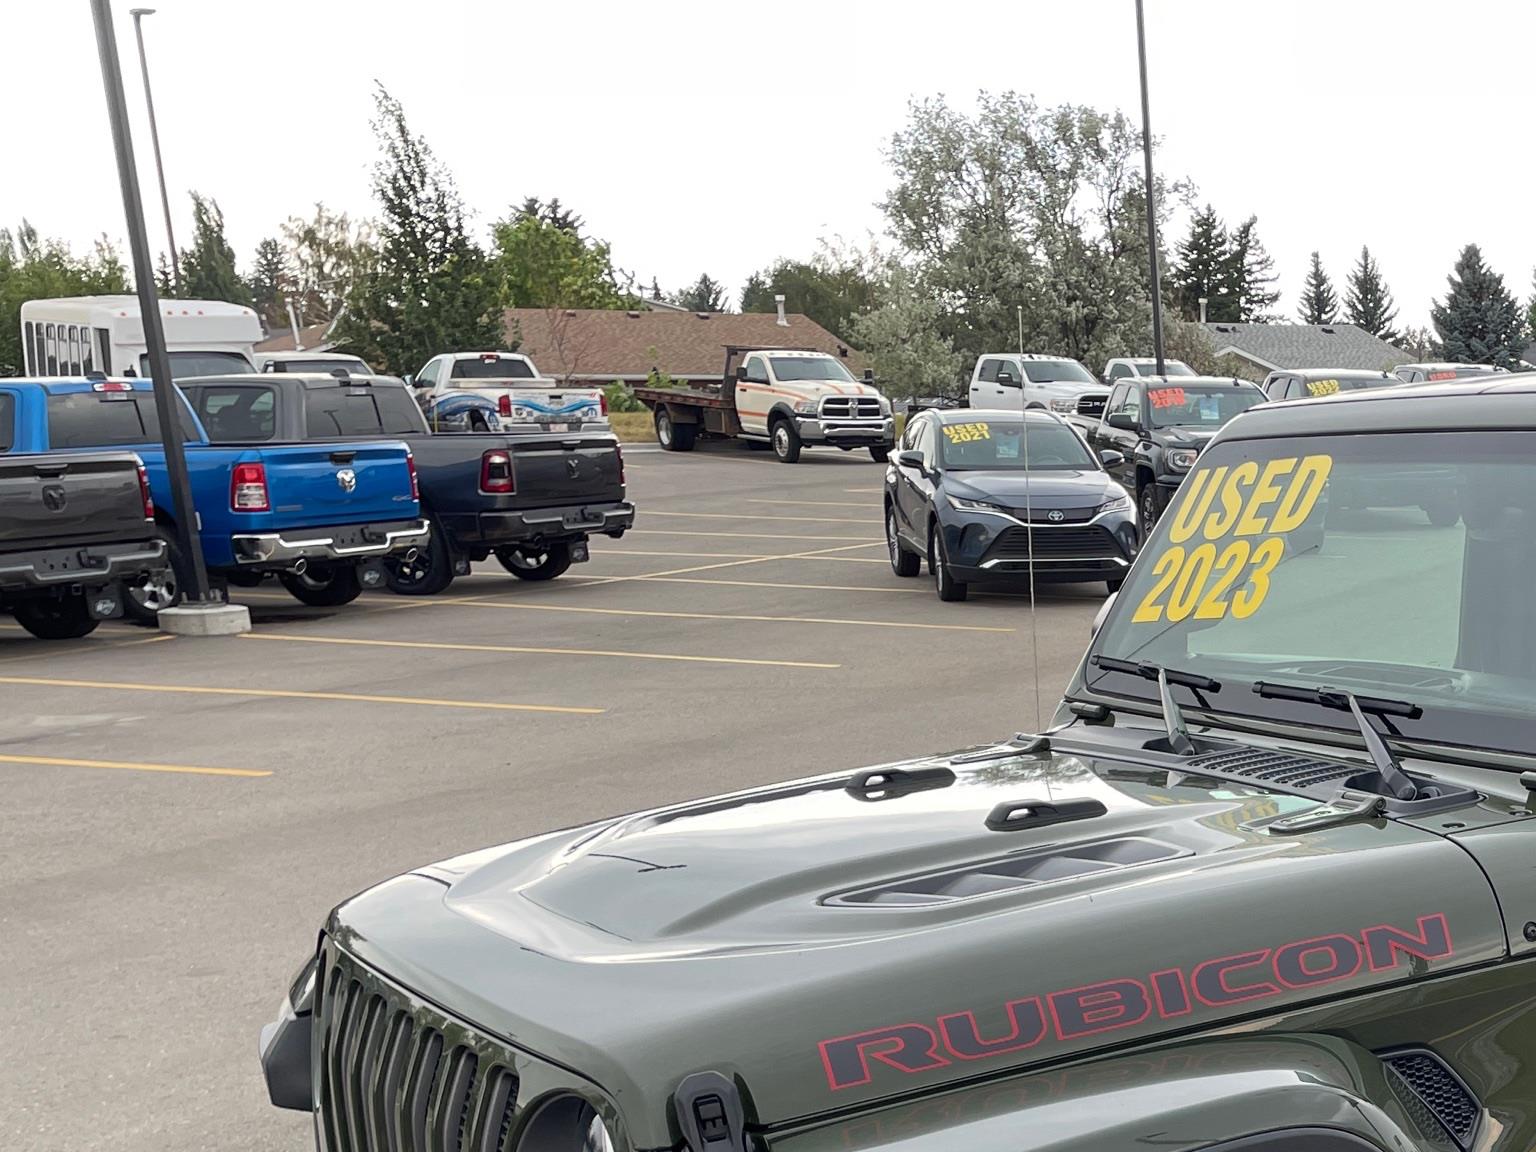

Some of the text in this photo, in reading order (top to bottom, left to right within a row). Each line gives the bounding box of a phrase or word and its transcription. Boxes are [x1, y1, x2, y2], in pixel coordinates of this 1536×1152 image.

[943, 422, 989, 436] USED
[951, 430, 991, 444] 2021
[1169, 454, 1333, 544] USED
[1131, 537, 1285, 624] 2023
[817, 912, 1454, 1091] RUBICON
